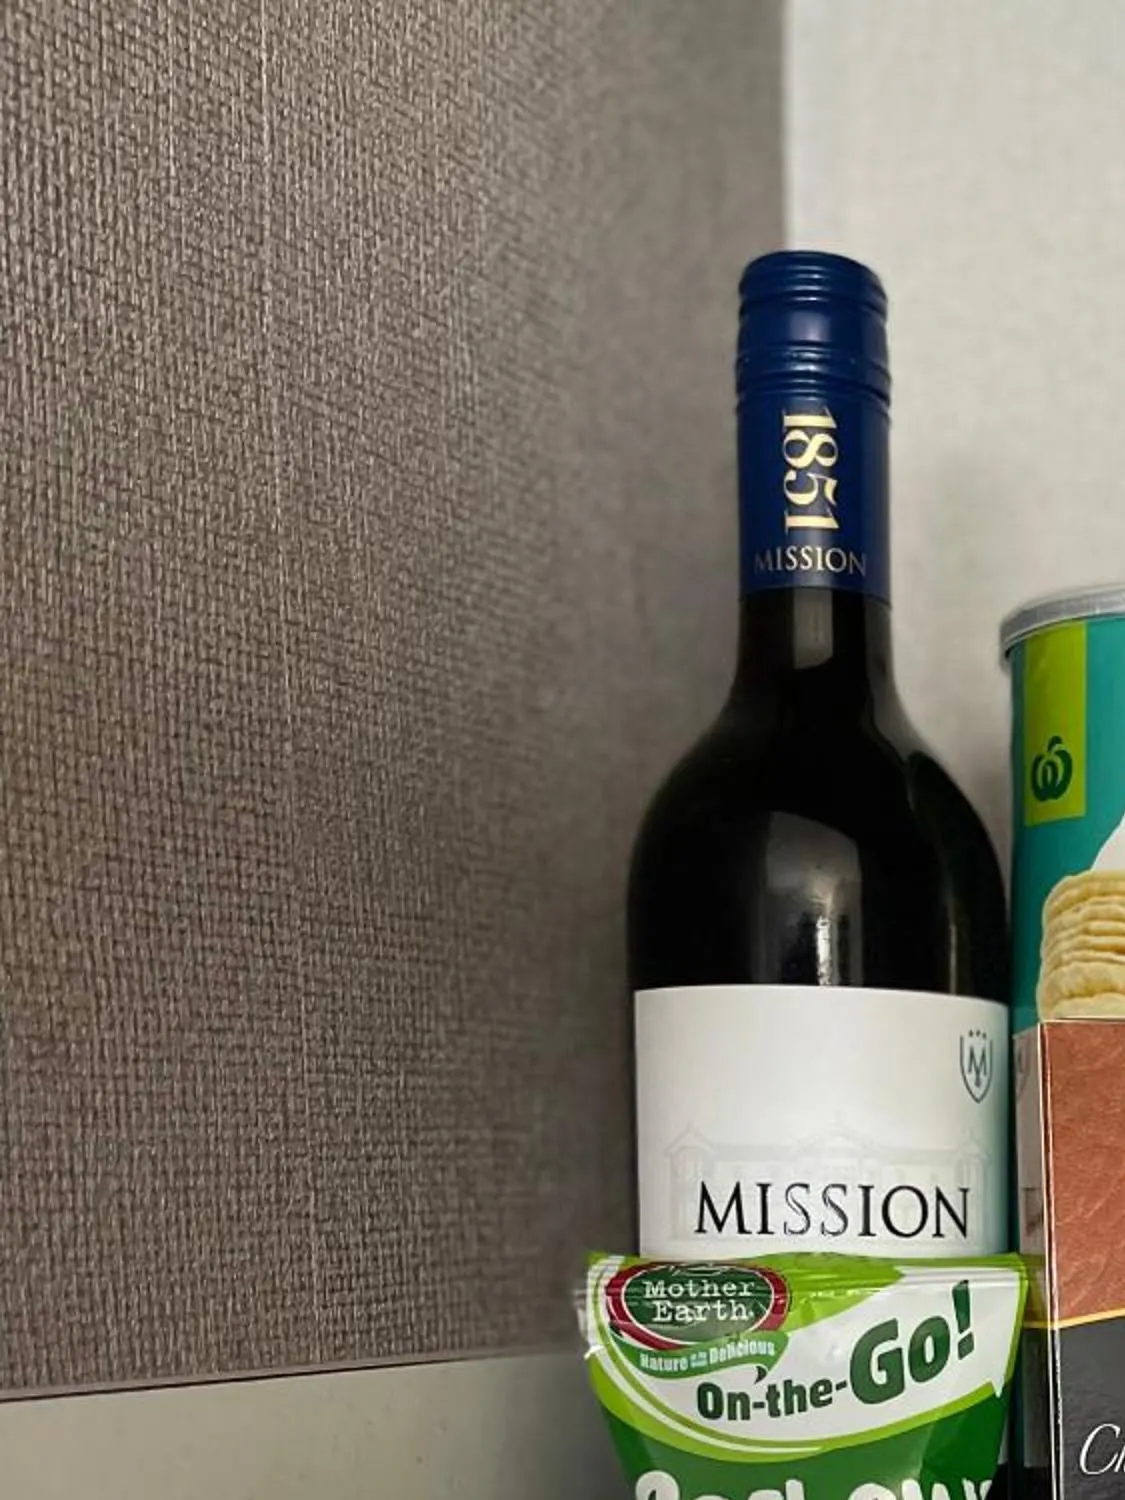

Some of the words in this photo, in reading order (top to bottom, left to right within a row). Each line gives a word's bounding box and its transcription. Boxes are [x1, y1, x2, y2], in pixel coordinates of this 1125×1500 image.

[782, 405, 839, 533] 1851
[754, 545, 867, 576] MISSION
[694, 1181, 970, 1240] MISSION
[641, 1278, 755, 1299] Mother
[652, 1300, 751, 1323] Earth
[640, 1352, 689, 1371] Nature
